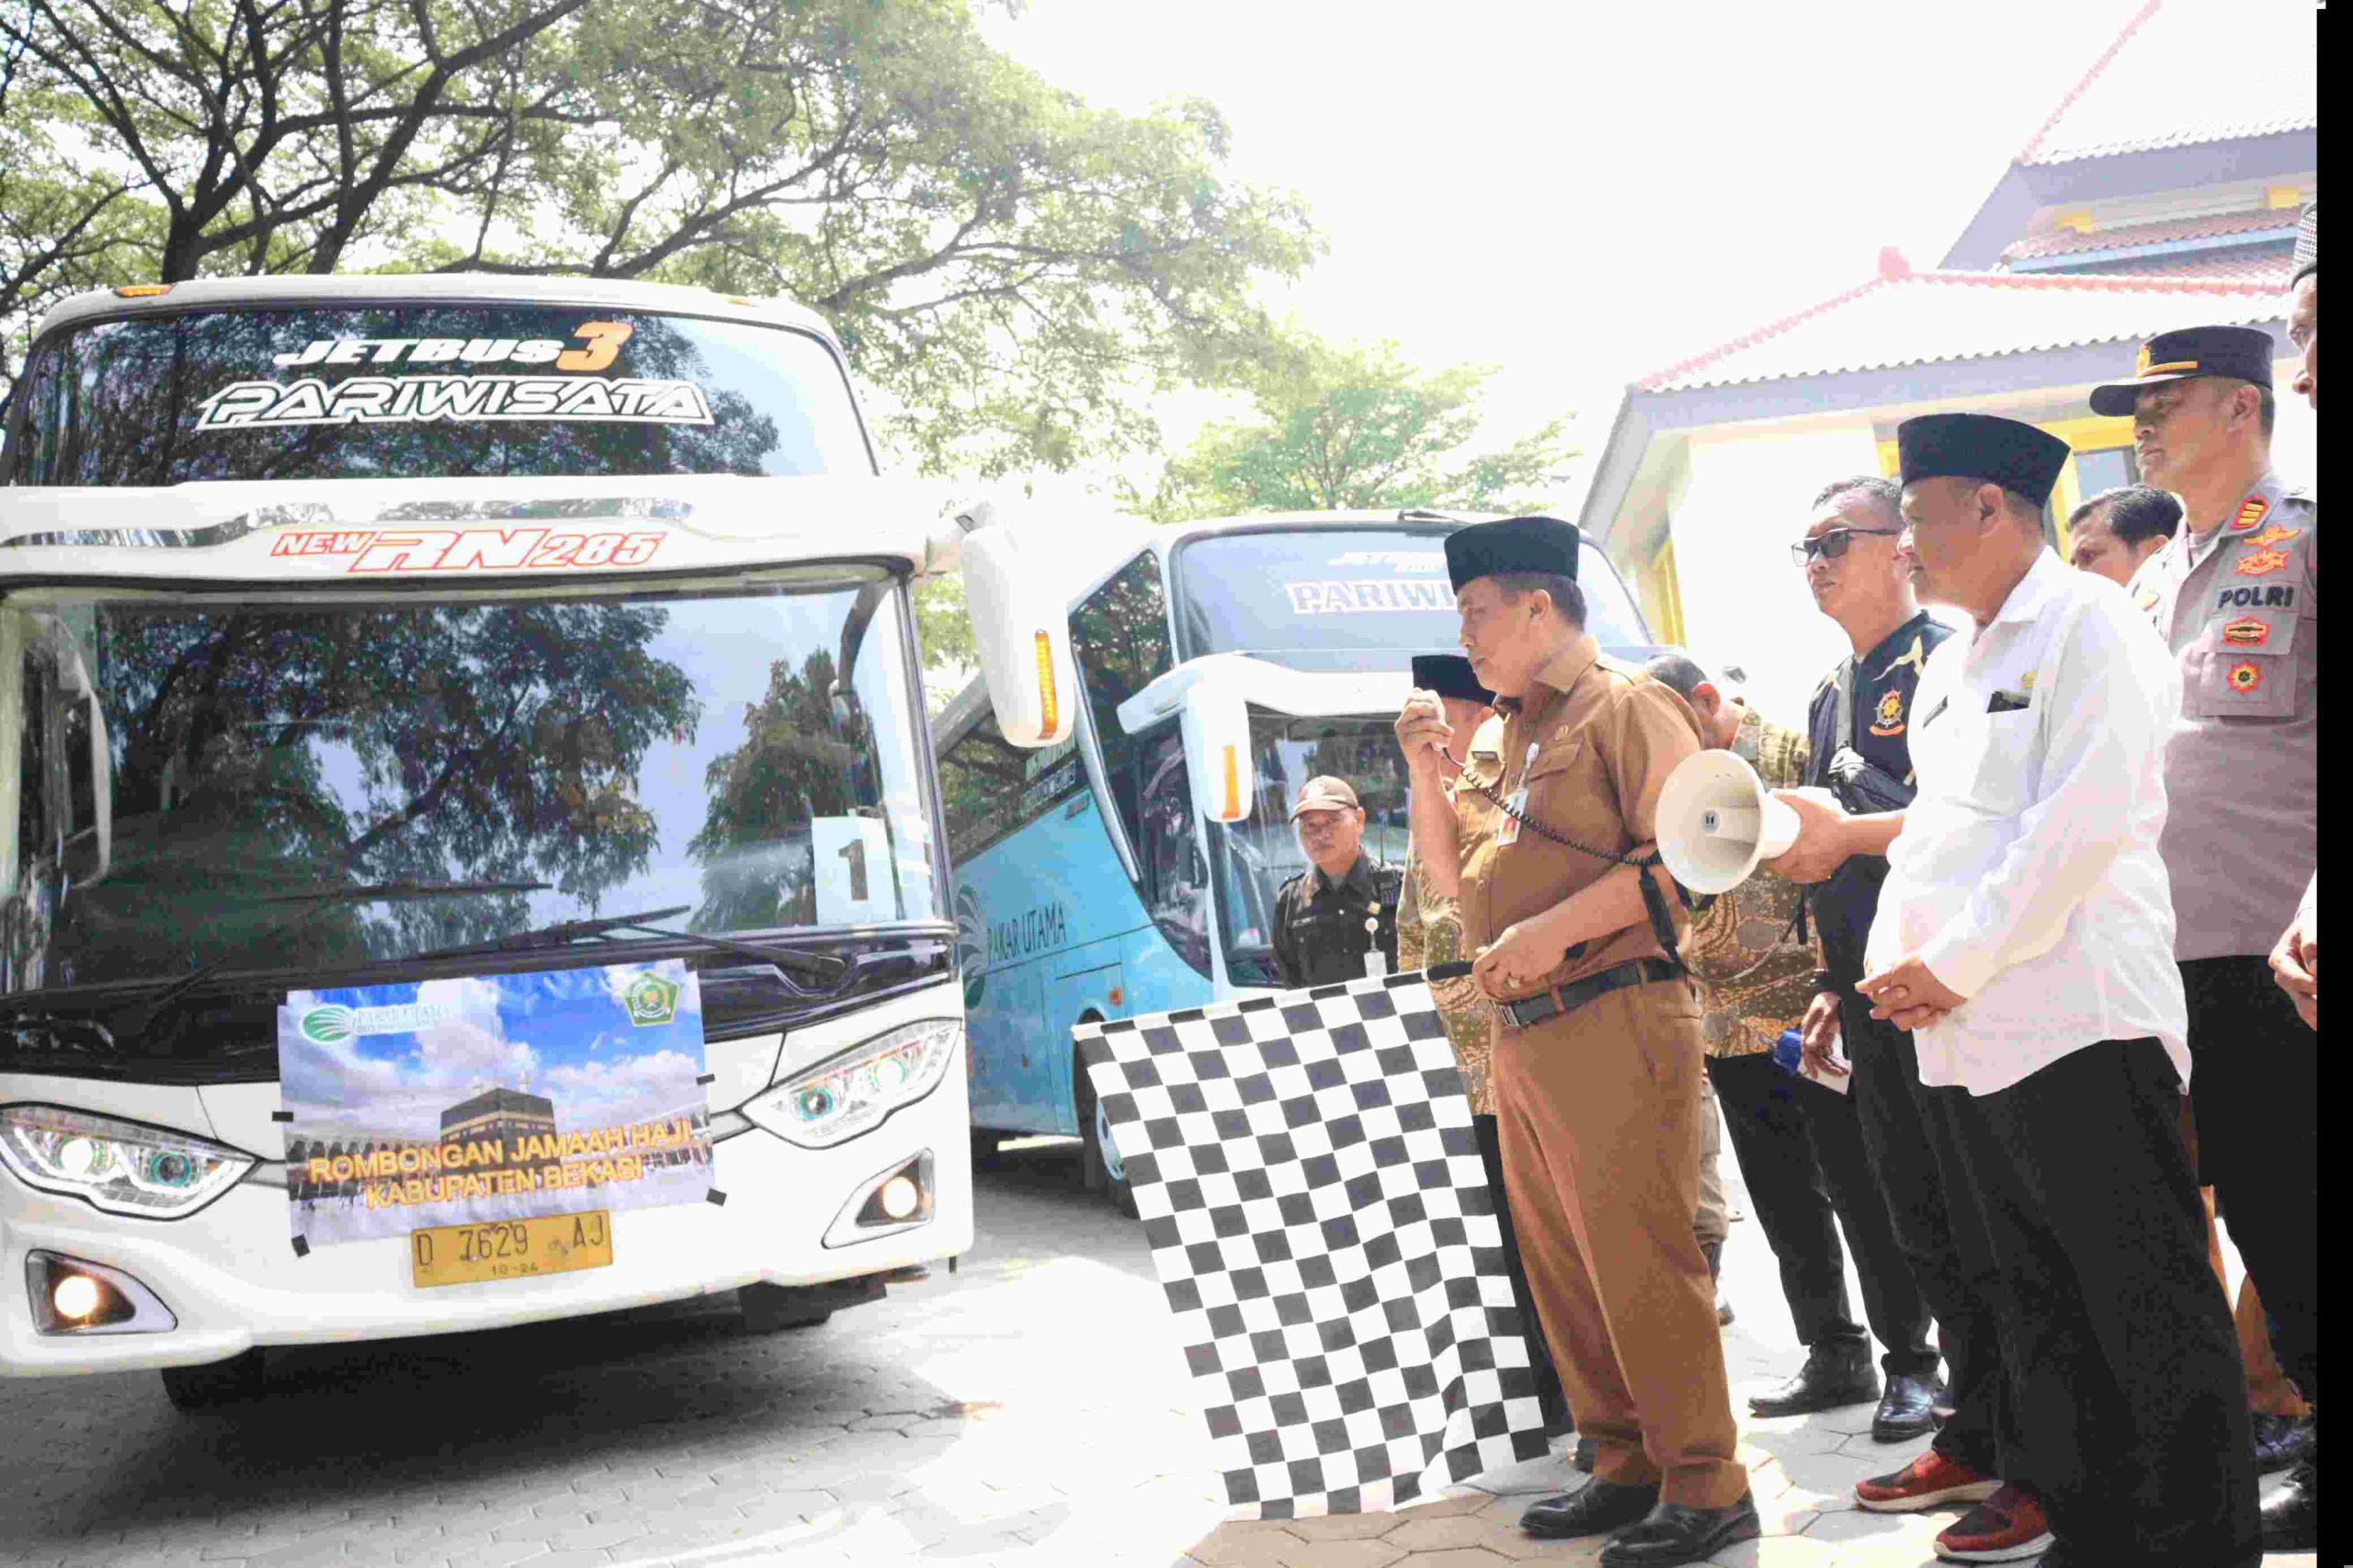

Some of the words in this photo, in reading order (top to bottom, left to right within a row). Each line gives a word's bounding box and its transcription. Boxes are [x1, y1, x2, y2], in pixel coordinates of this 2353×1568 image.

[199, 376, 713, 429] PARIWISATA
[270, 531, 376, 555] NEW
[529, 532, 667, 567] 285
[2218, 585, 2295, 608] POLRI
[837, 838, 869, 901] 1
[986, 919, 1019, 965] PAKAR
[1022, 902, 1067, 953] UTAMA
[309, 1141, 505, 1184] ROMBONGAN
[510, 1130, 624, 1162] JAMAAH
[631, 1119, 693, 1149] HAJI
[365, 1167, 536, 1209] KABUPATEN
[542, 1156, 644, 1190] BEKASI
[416, 1233, 434, 1267] D
[459, 1223, 529, 1262] 7629
[573, 1214, 604, 1248] AJ
